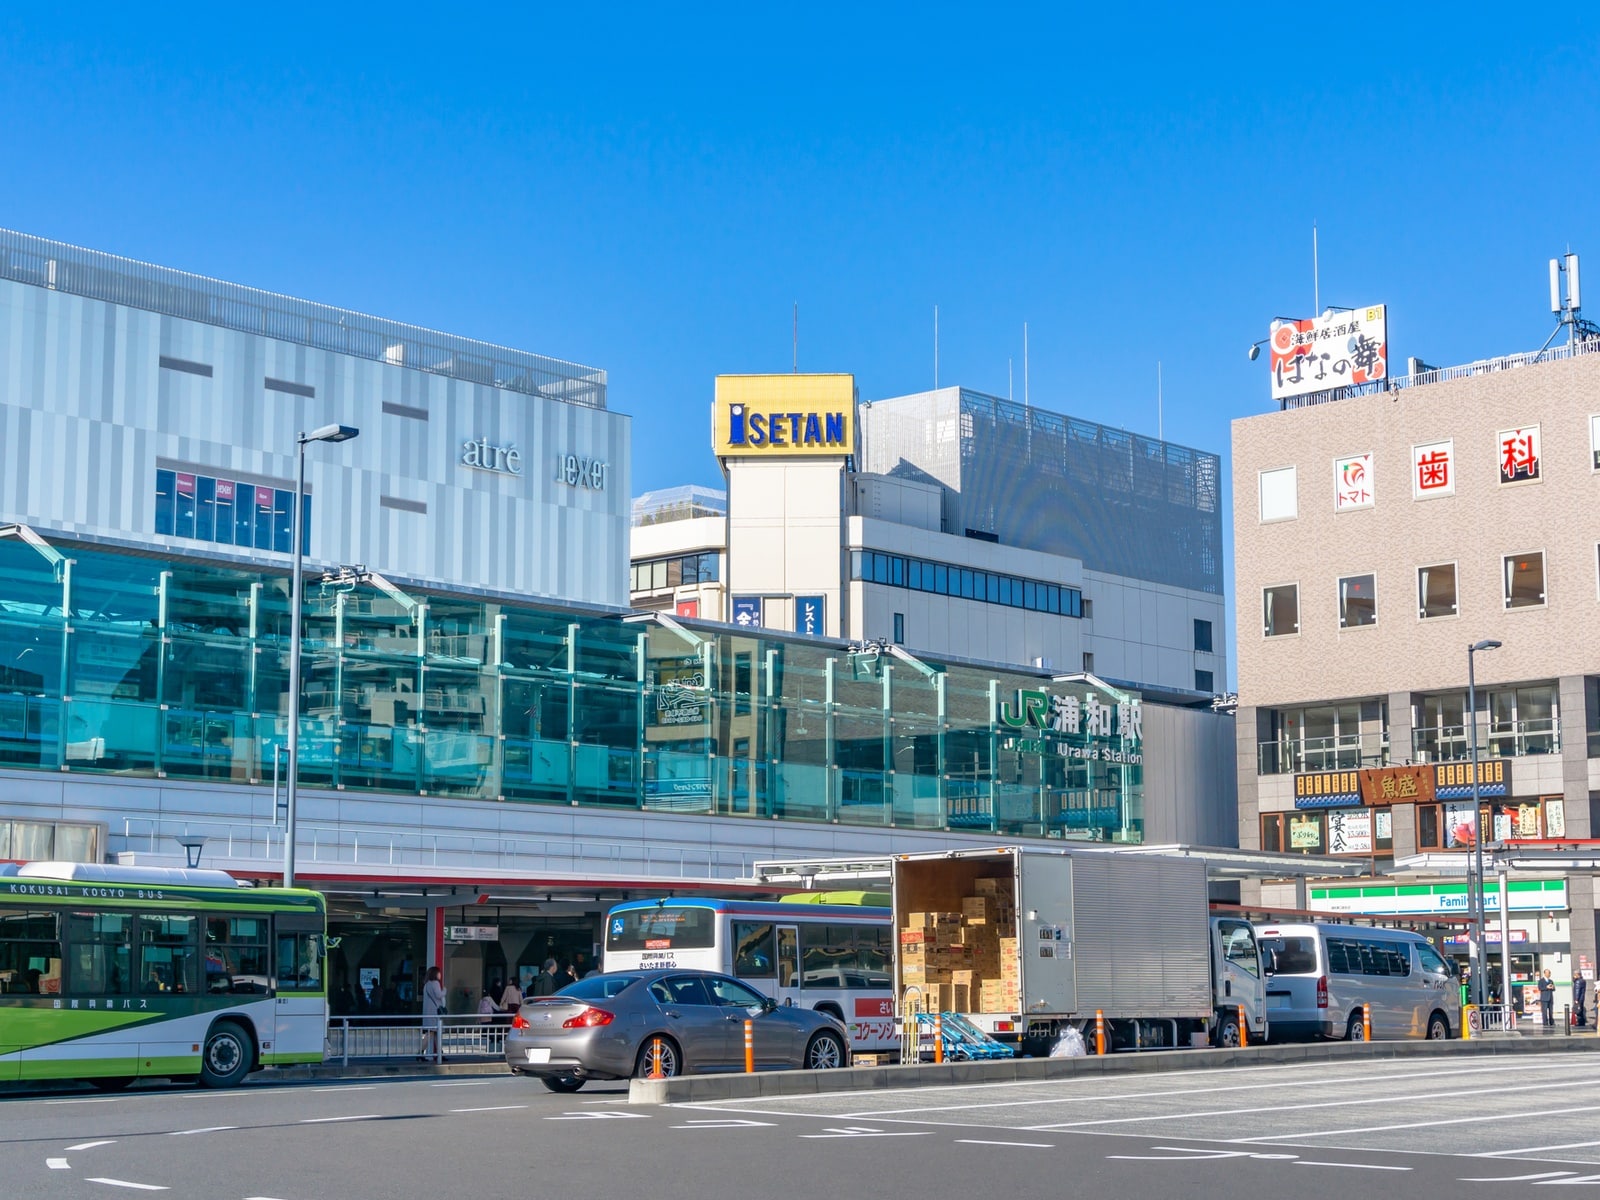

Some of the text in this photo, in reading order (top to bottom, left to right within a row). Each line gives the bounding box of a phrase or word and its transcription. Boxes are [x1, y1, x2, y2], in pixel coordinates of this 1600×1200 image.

[1366, 307, 1382, 322] B1
[1291, 320, 1361, 346] 海鮮居酒屋
[1276, 333, 1381, 388] はなの舞
[727, 403, 844, 445] ISETAN
[463, 436, 521, 475] atré
[1338, 435, 1537, 507] トマト 歯 科
[804, 603, 816, 635] レスト
[1001, 688, 1144, 741] JR 浦和駅
[1058, 742, 1143, 765] Urawa Station
[1381, 773, 1419, 800] 魚盛
[1329, 811, 1347, 852] 宴会
[10, 884, 164, 899] KOKUSAI KOGYO BUS
[1440, 895, 1497, 908] Familart
